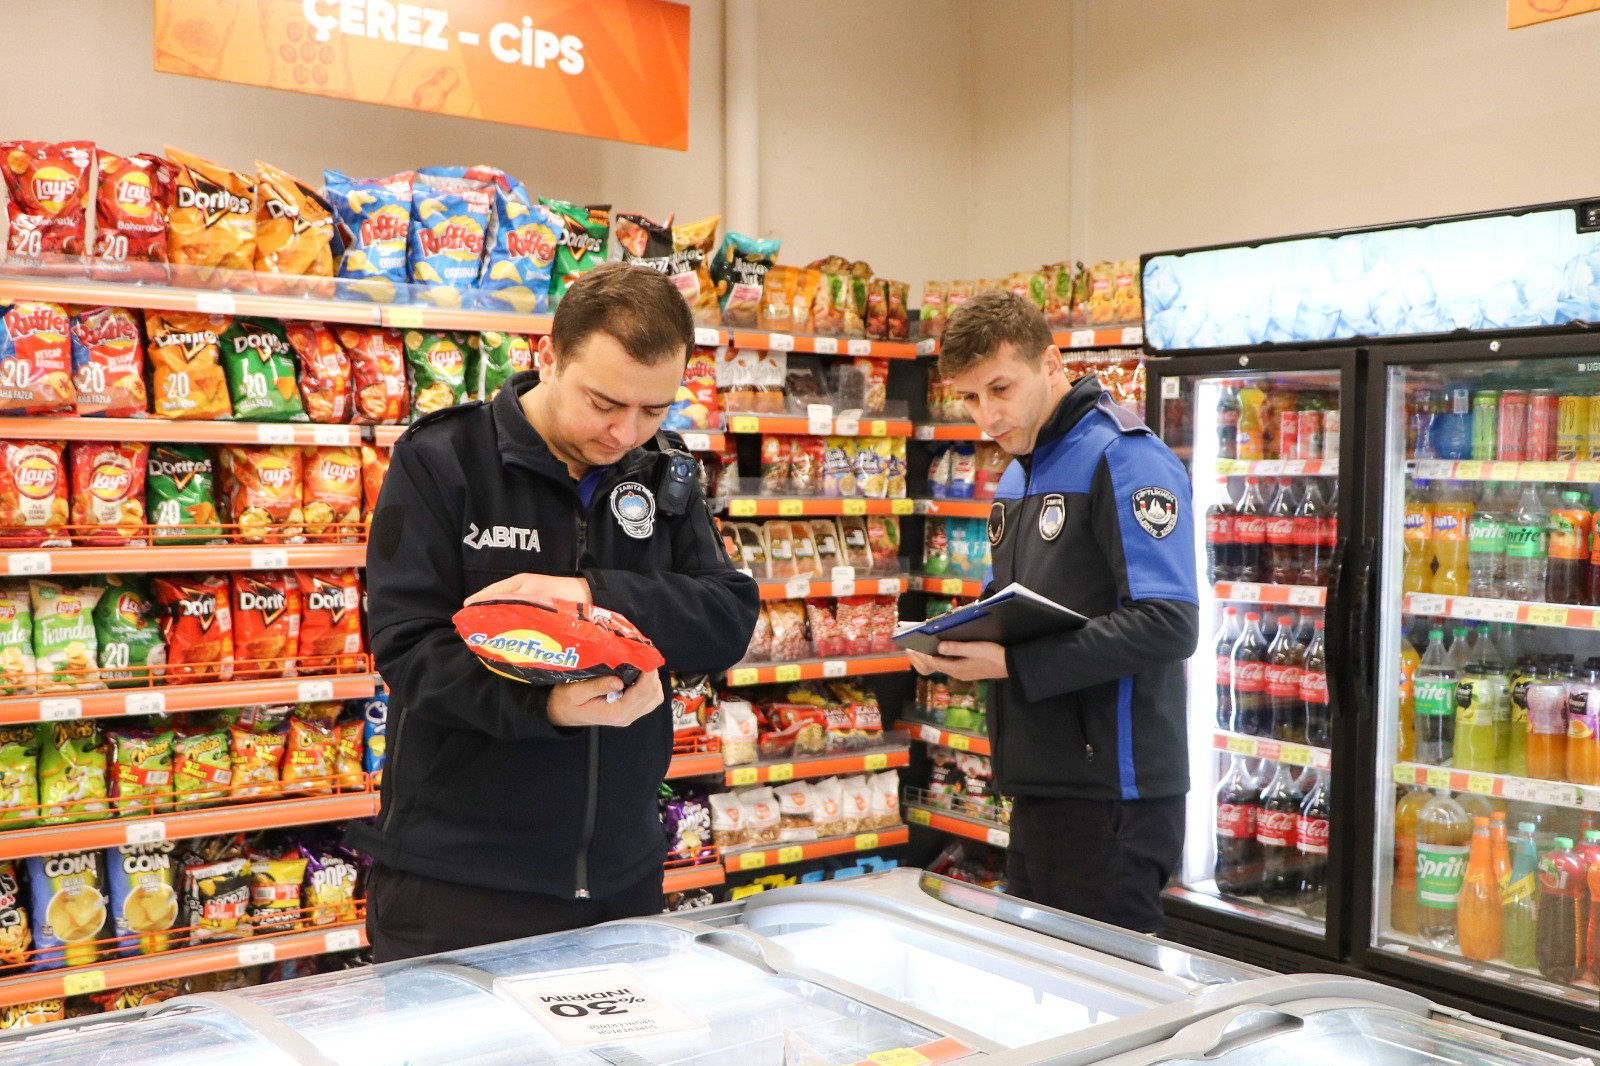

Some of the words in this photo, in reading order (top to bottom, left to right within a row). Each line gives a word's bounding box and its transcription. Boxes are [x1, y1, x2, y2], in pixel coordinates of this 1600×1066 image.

[303, 0, 449, 53] ÇEREZ
[178, 185, 250, 215] Doritos
[417, 222, 485, 259] Ruffles
[3, 307, 70, 341] Ruffles
[19, 467, 56, 488] Lay's
[149, 459, 212, 477] Doritos
[322, 461, 358, 484] Lay's
[463, 523, 541, 552] ZABITA
[466, 633, 579, 668] SuperFresh
[45, 852, 97, 878] COIN
[123, 854, 170, 874] COIN
[314, 864, 357, 894] POPS
[540, 988, 633, 1003] İNDİRİM
